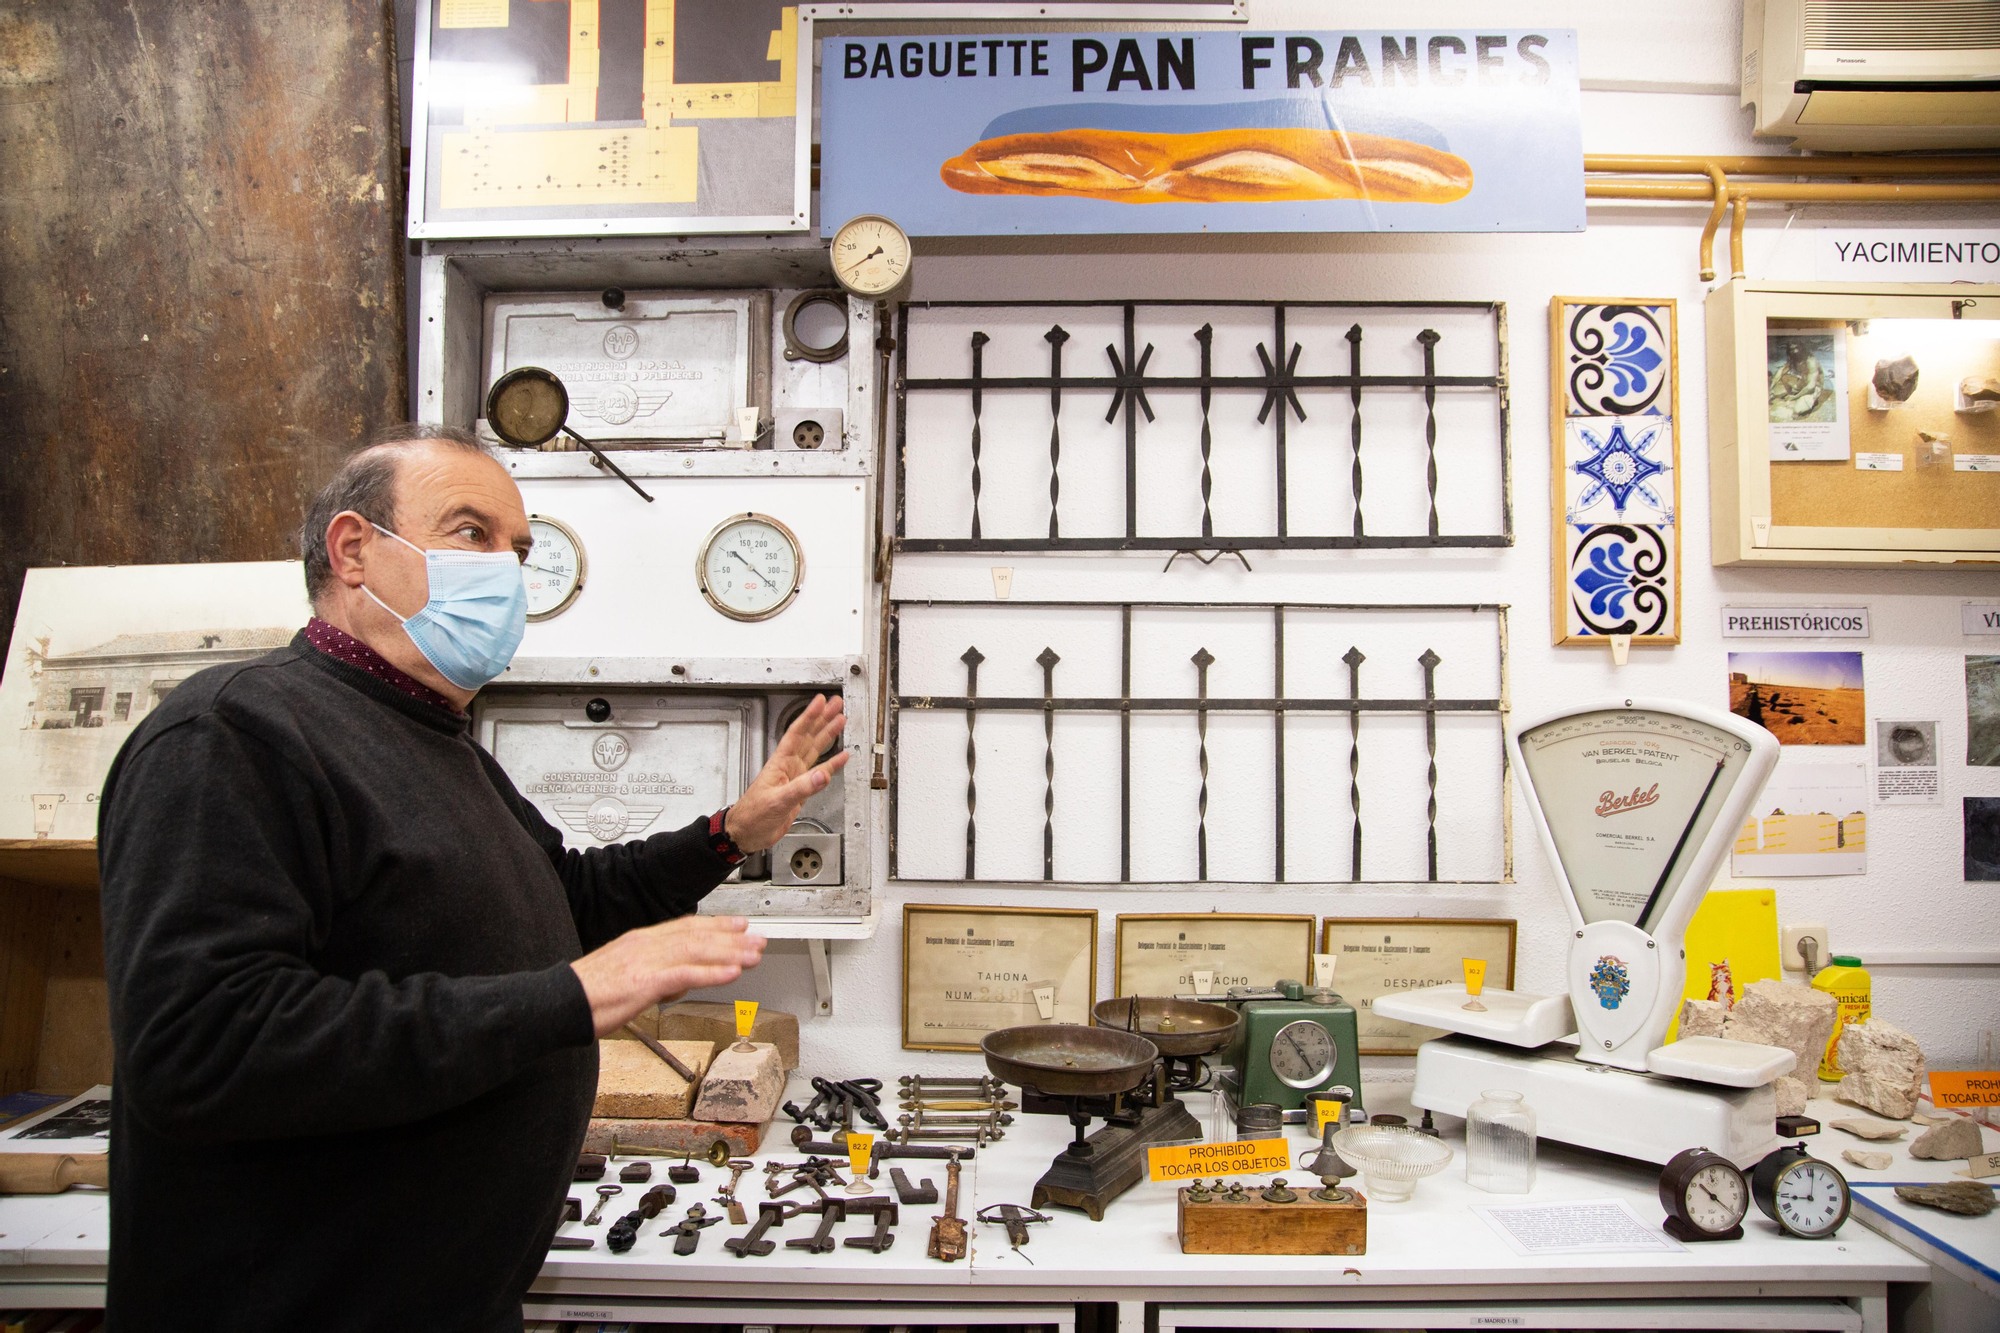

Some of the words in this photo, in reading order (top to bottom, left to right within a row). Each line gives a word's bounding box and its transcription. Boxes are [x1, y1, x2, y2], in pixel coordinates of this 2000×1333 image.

[844, 40, 1049, 78] BAGUETTE
[1072, 38, 1195, 92] PAN
[1241, 35, 1550, 89] FRANCES
[1834, 241, 2000, 263] YACIMIENTO
[555, 361, 627, 372] CONSTRUCCION
[586, 372, 626, 382] WERNER
[630, 372, 639, 382] &
[642, 371, 702, 381] PFLEIDERER
[549, 552, 562, 560] 250
[1728, 613, 1863, 631] PREHISTÓRICOS
[1582, 750, 1600, 758] VAN
[1644, 748, 1680, 762] PATENT
[543, 772, 618, 783] CONSTRUCCION
[628, 774, 677, 784] I.P.S.A.
[526, 784, 574, 794] LICENCIA
[576, 785, 616, 794] WERNER
[620, 785, 629, 795] &
[632, 785, 695, 795] PFLEIDERER
[1595, 782, 1660, 818] Berkel
[978, 972, 1028, 982] TAHONA
[1179, 976, 1248, 986] DEACHO
[946, 990, 976, 1000] NUM.
[1942, 1093, 1981, 1104] TOCAR
[1982, 1093, 2000, 1103] LO
[1189, 1144, 1256, 1158] PROHIBIDO
[1160, 1163, 1202, 1176] TOCAR
[1205, 1161, 1229, 1173] LOS
[1232, 1156, 1286, 1170] OBJETOS
